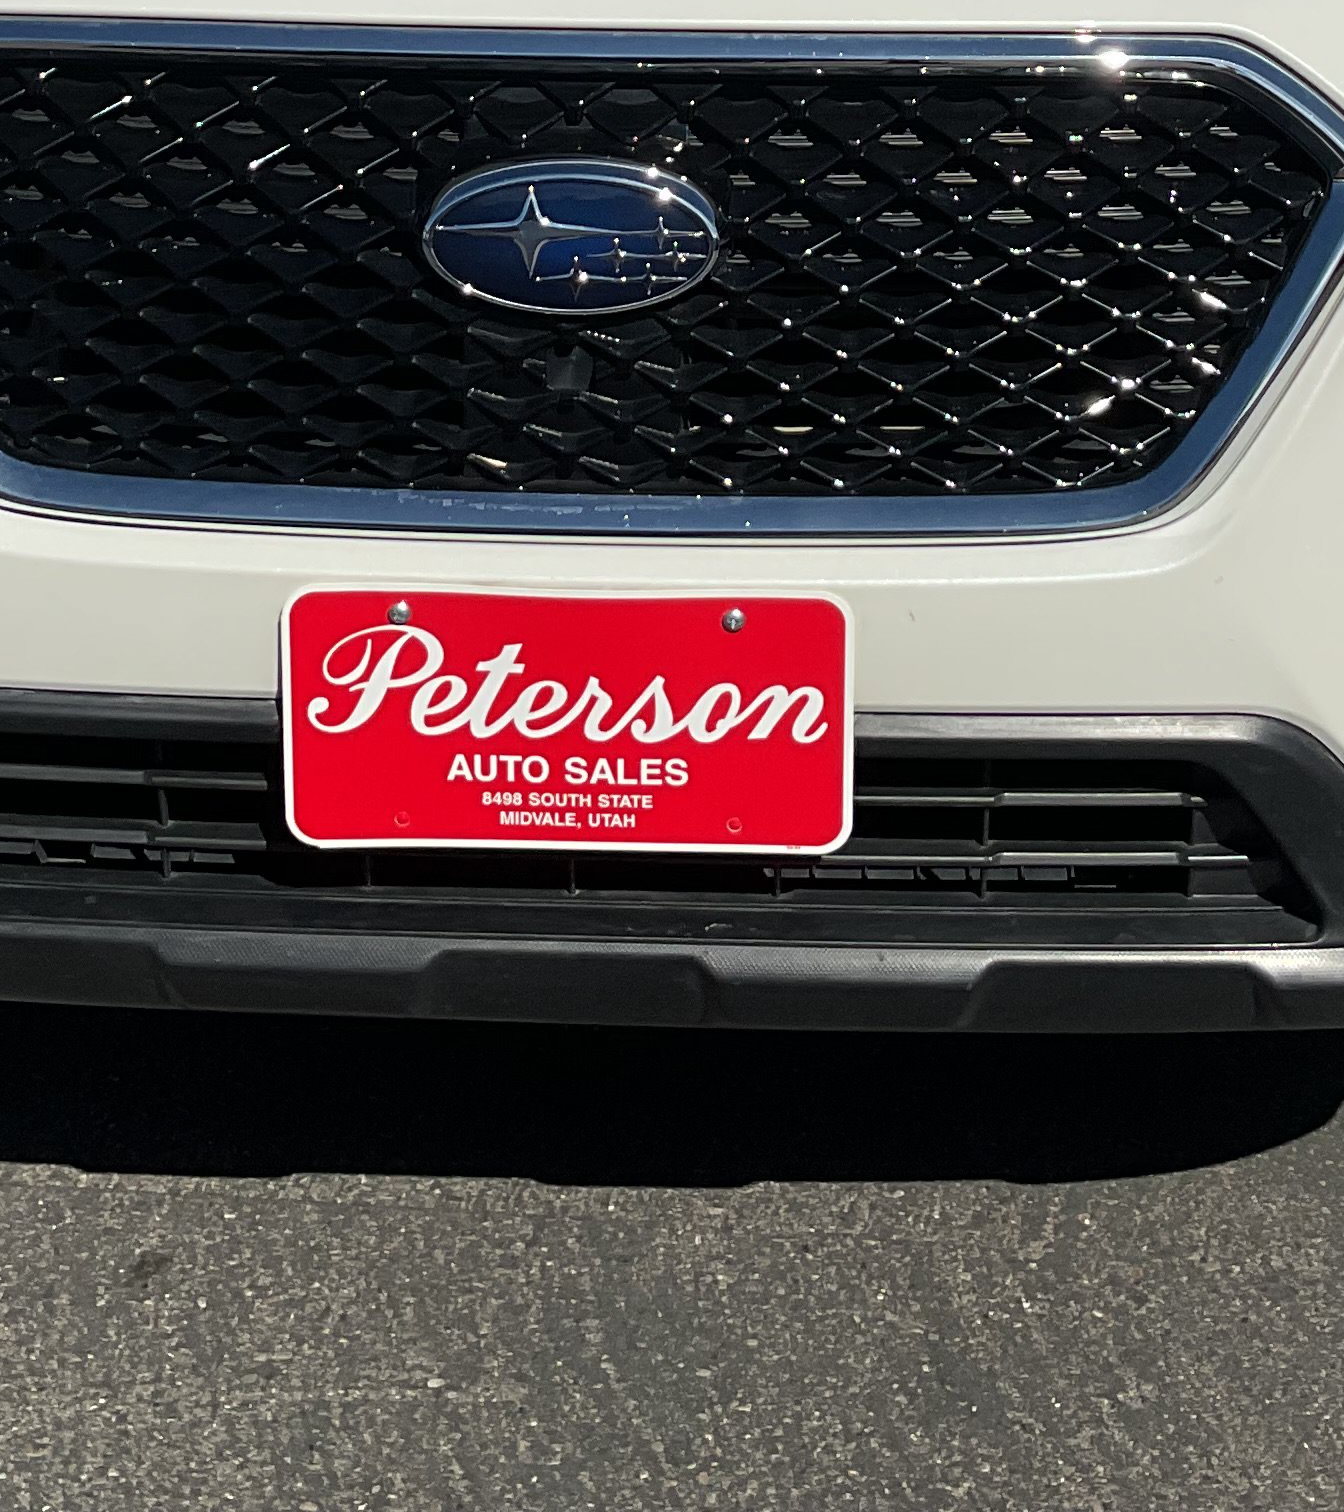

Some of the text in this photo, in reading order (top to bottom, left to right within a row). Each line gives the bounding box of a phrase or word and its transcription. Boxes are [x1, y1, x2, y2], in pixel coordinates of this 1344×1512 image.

[306, 623, 829, 744] Peterson
[446, 753, 689, 786] AUTO SALES
[481, 791, 654, 809] 8498 SOUTH STATE
[499, 810, 636, 829] MIDVALE, UTAH
